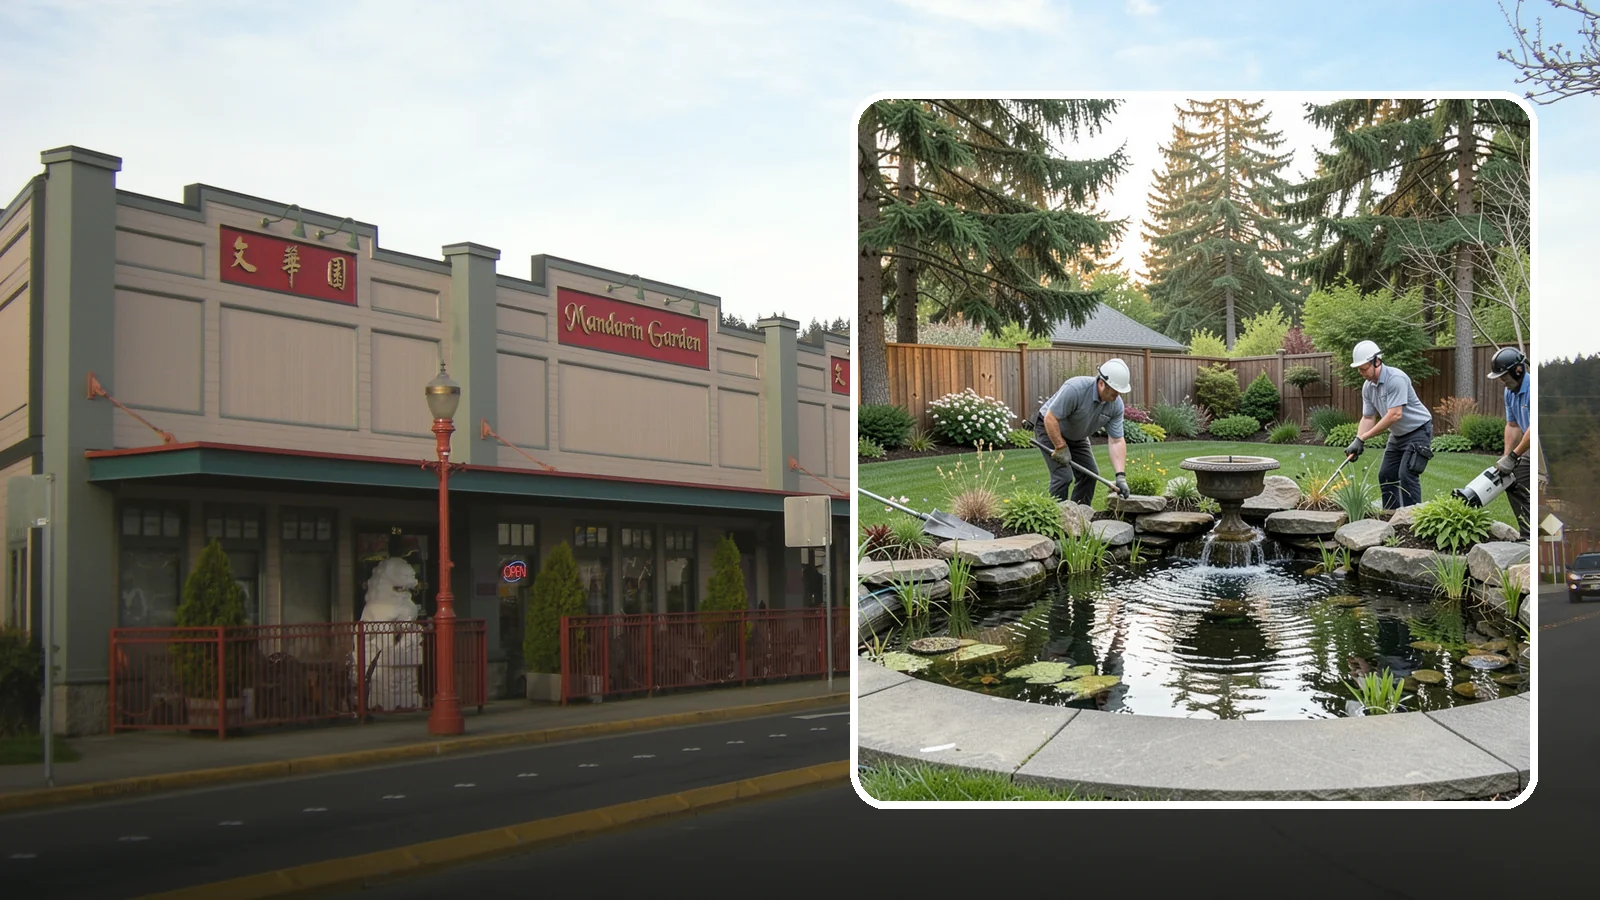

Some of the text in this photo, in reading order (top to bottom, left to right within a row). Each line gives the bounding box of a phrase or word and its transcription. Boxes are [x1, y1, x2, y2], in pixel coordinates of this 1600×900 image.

[231, 235, 346, 291] 文華園
[564, 302, 702, 352] Mandarin Garden
[835, 363, 846, 386] 文
[503, 565, 527, 578] OPEN
